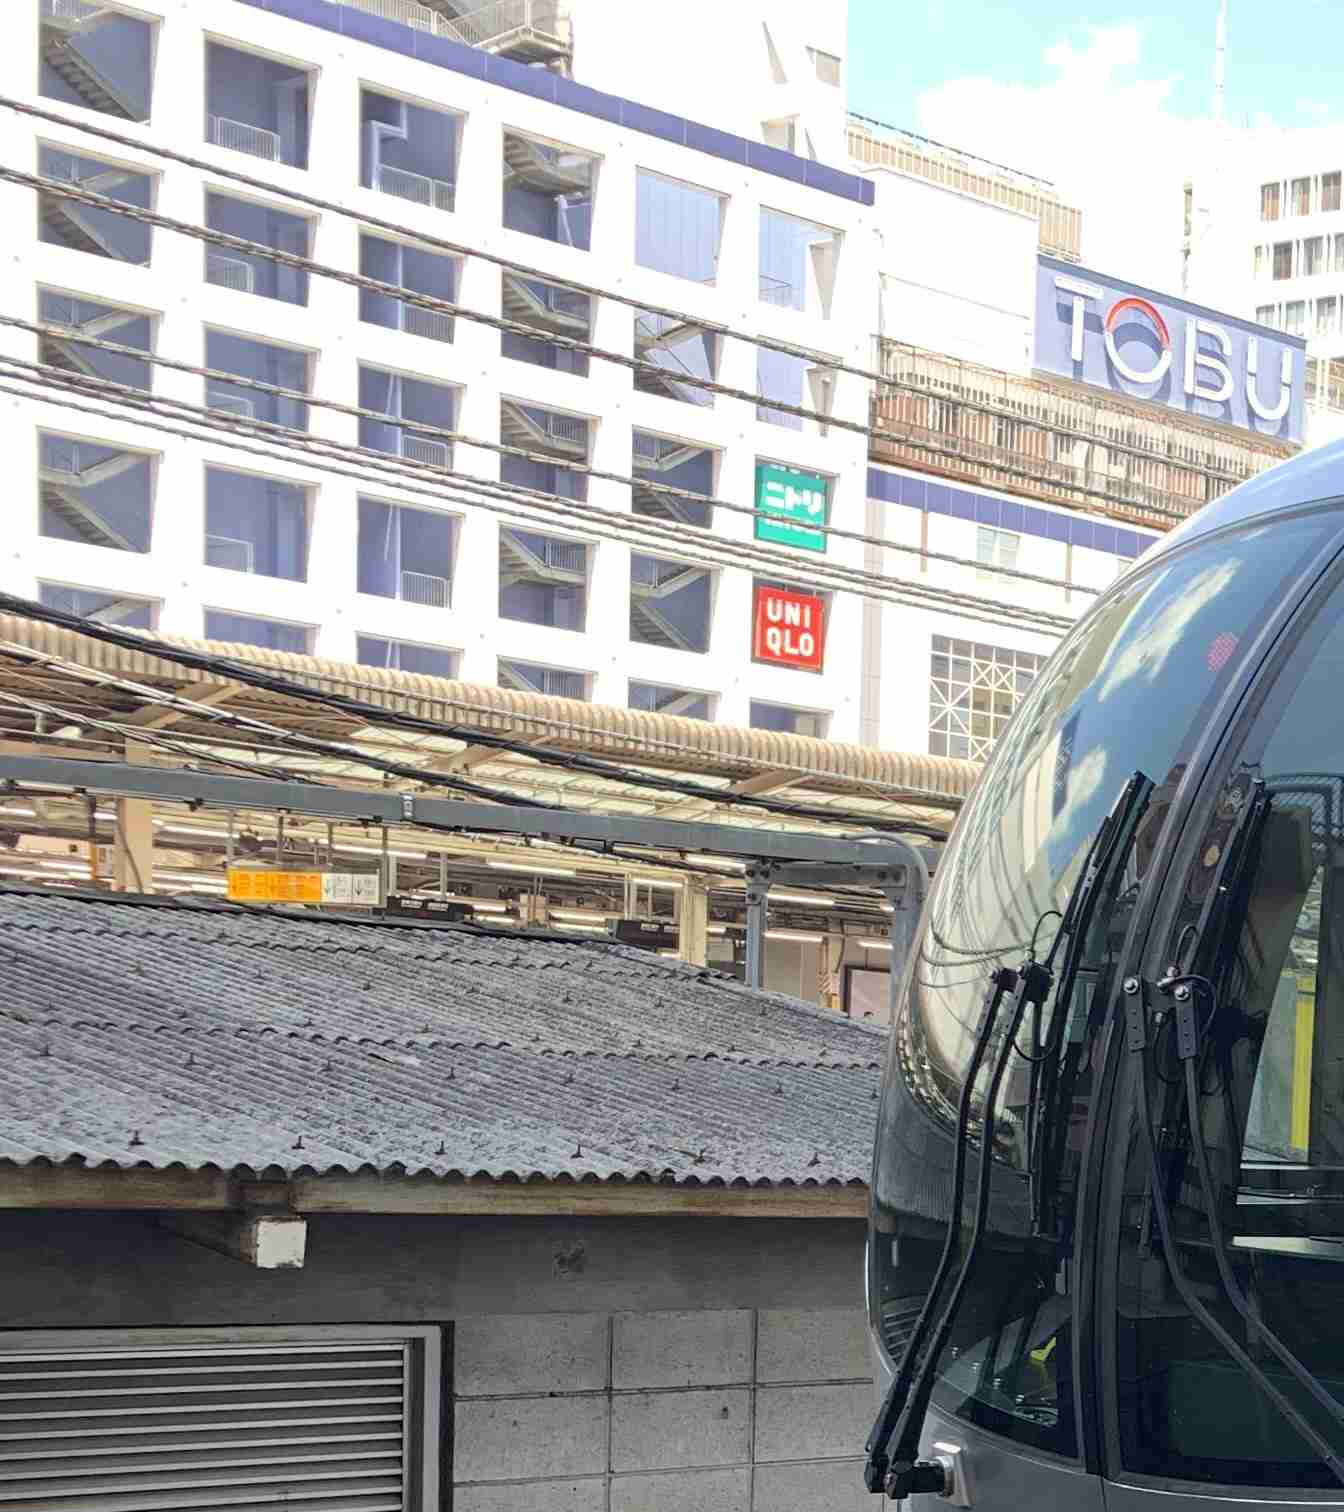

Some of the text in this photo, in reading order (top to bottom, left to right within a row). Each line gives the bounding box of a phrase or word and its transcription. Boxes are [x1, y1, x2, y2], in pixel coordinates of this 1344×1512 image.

[1054, 275, 1293, 421] TOBU
[766, 480, 822, 516] ニトリ
[767, 597, 811, 629] UNI
[766, 626, 814, 657] QLO
